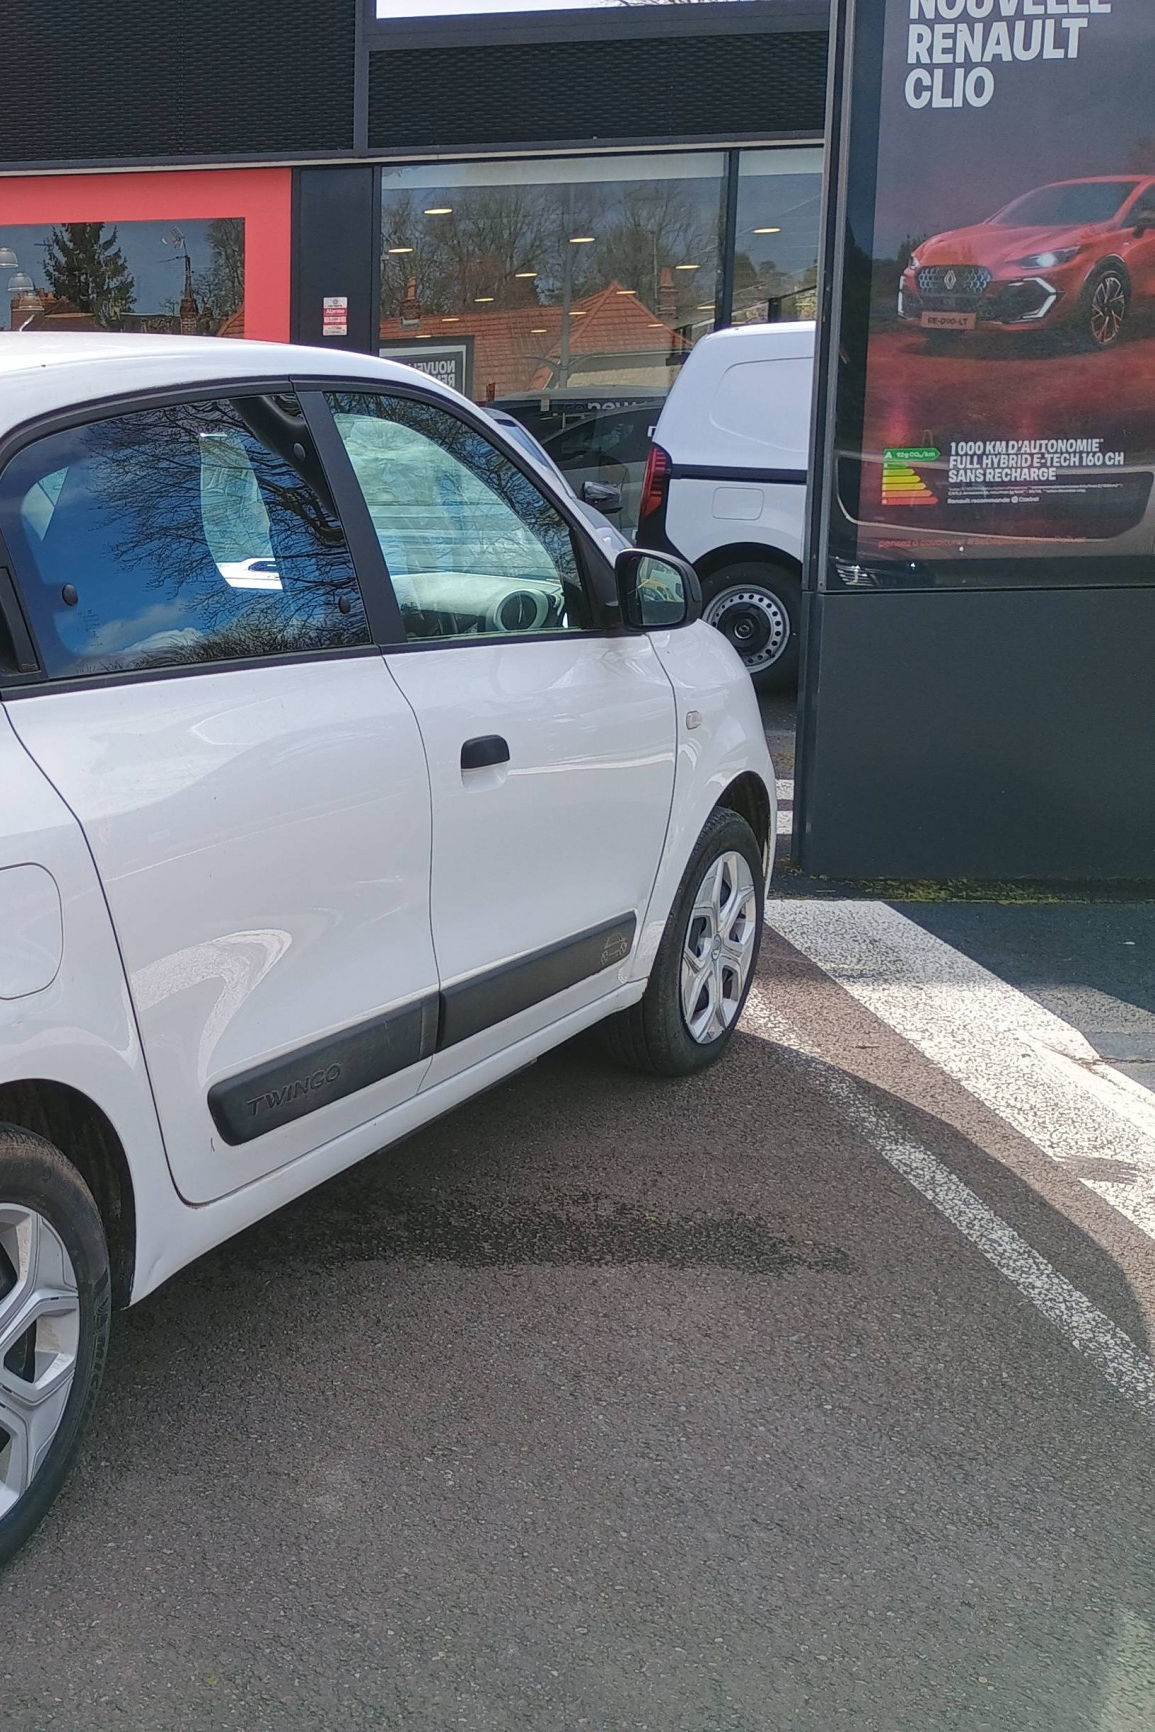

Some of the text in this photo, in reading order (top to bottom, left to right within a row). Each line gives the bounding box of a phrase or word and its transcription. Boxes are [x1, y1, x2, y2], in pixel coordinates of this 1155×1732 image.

[907, 17, 1088, 64] RENAULT
[905, 66, 995, 109] CLIO
[948, 452, 1124, 469] FULL HYBRID E-TECH 160 CH
[987, 441, 1007, 454] KM
[948, 468, 1057, 483] SANS RECHARGE
[246, 1062, 342, 1117] TWINGO
